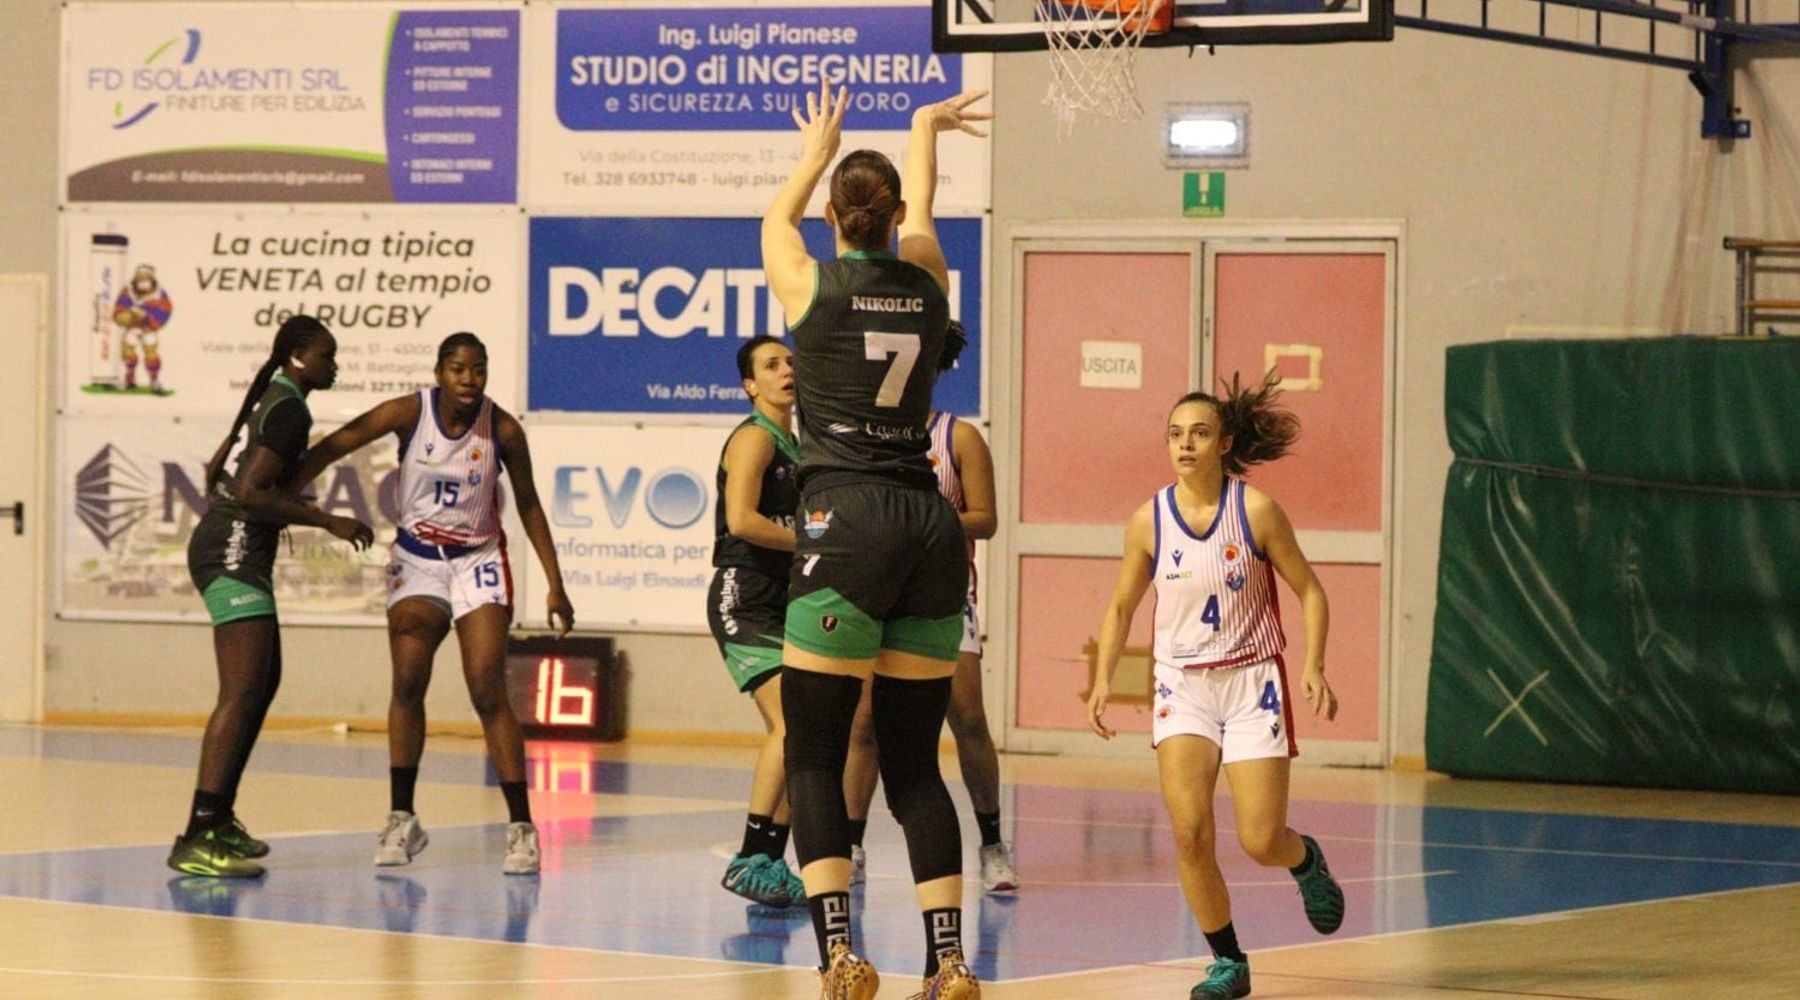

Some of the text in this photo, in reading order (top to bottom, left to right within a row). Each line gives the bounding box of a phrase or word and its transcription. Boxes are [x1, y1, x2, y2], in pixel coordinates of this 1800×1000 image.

[658, 23, 859, 50] Ing. Luigi Pianese
[87, 67, 349, 91] FD ISOLAMENTI SRL
[570, 53, 947, 86] STUDIO di INGEGNERIA
[166, 94, 366, 112] FINITURE PER EDILIZIA
[604, 97, 620, 112] e
[628, 92, 753, 113] SICUREZZA
[579, 149, 604, 164] Via
[607, 149, 647, 164] della
[650, 149, 755, 165] Costituzione,
[562, 172, 591, 186] Tel.
[594, 172, 623, 187] 328
[211, 230, 475, 263] La cucina tipica
[195, 267, 492, 300] VENETA al tempio
[315, 303, 432, 329] RUGBY
[852, 295, 924, 313] NIKOLIC
[863, 330, 922, 408] 7
[1082, 356, 1137, 374] USCITA
[646, 383, 671, 399] Via
[673, 383, 707, 399] Aldo
[433, 479, 461, 509] 15
[555, 536, 710, 566] nformatica per
[473, 560, 500, 589] 15
[802, 553, 822, 577] 7
[595, 570, 637, 591] Luigi
[1200, 593, 1222, 632] 4
[534, 657, 594, 726] 16
[1259, 679, 1282, 716] 4
